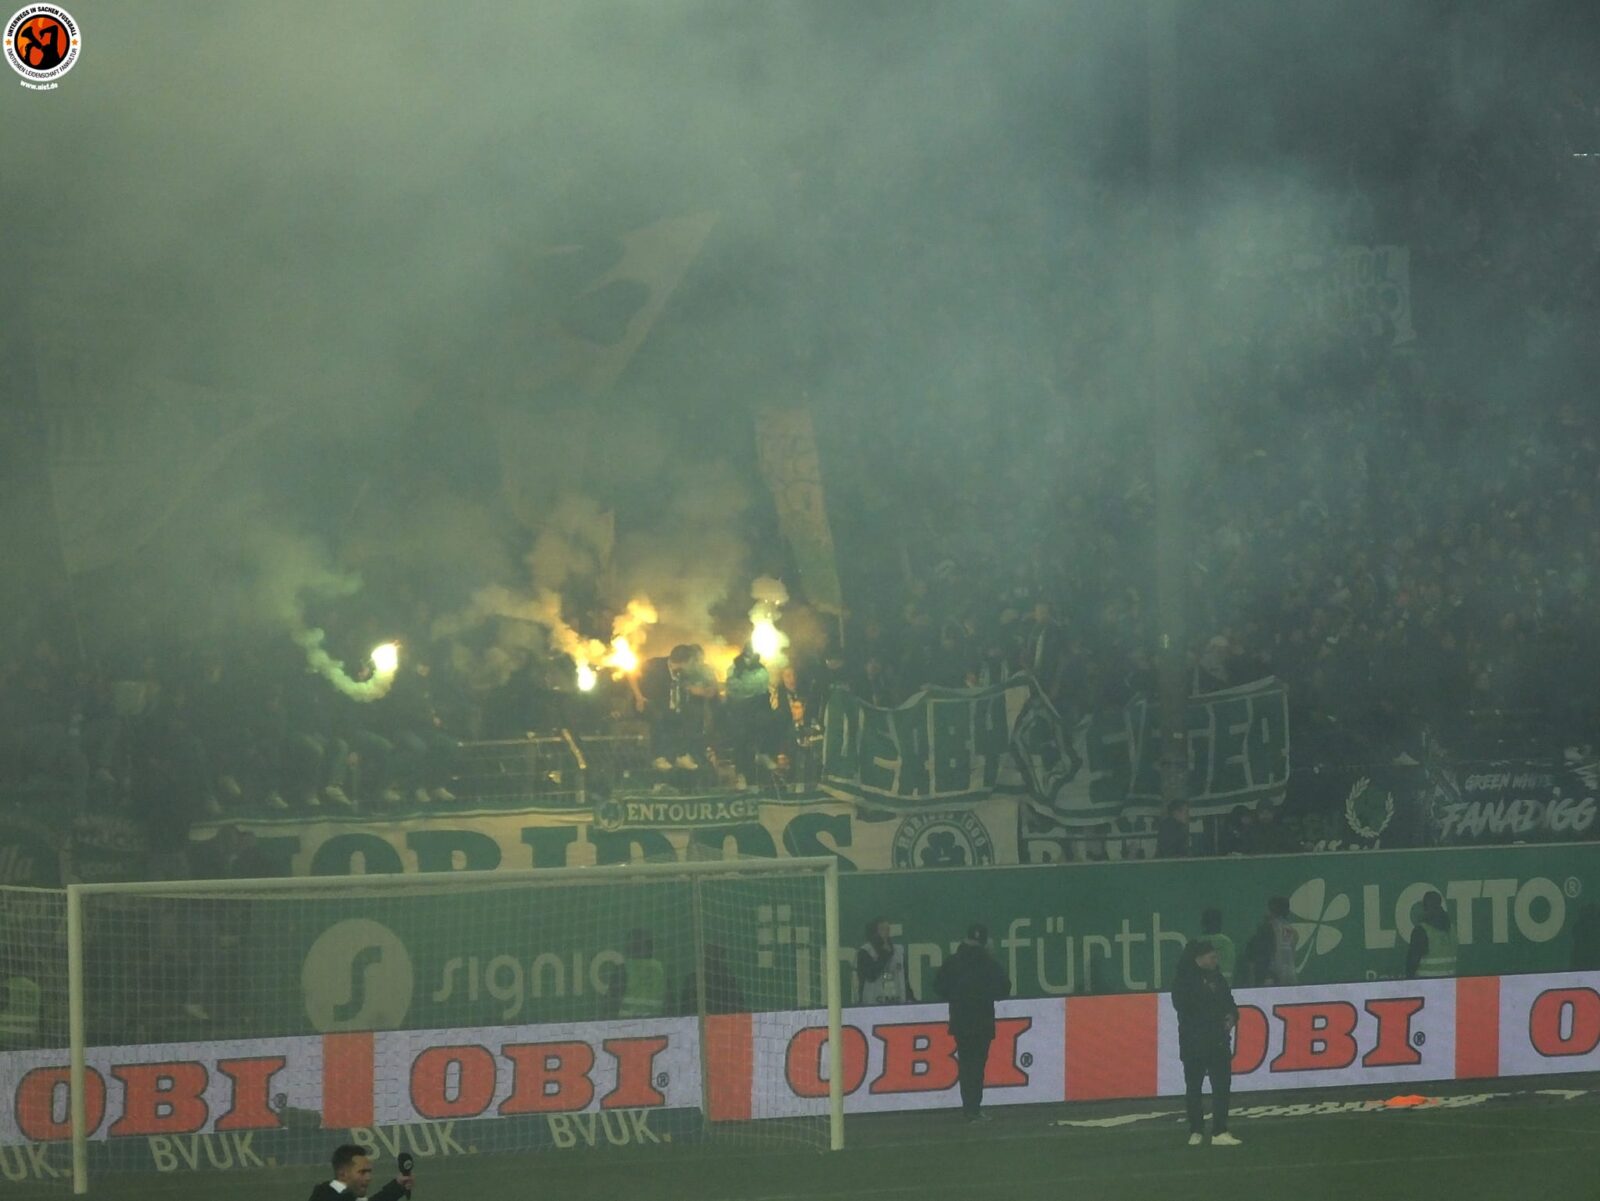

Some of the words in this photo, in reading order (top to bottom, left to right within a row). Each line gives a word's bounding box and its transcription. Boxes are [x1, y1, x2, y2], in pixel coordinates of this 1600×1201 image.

[627, 799, 759, 821] ENTOURAGE
[14, 1055, 287, 1142] OBI
[409, 1035, 668, 1120] OBI
